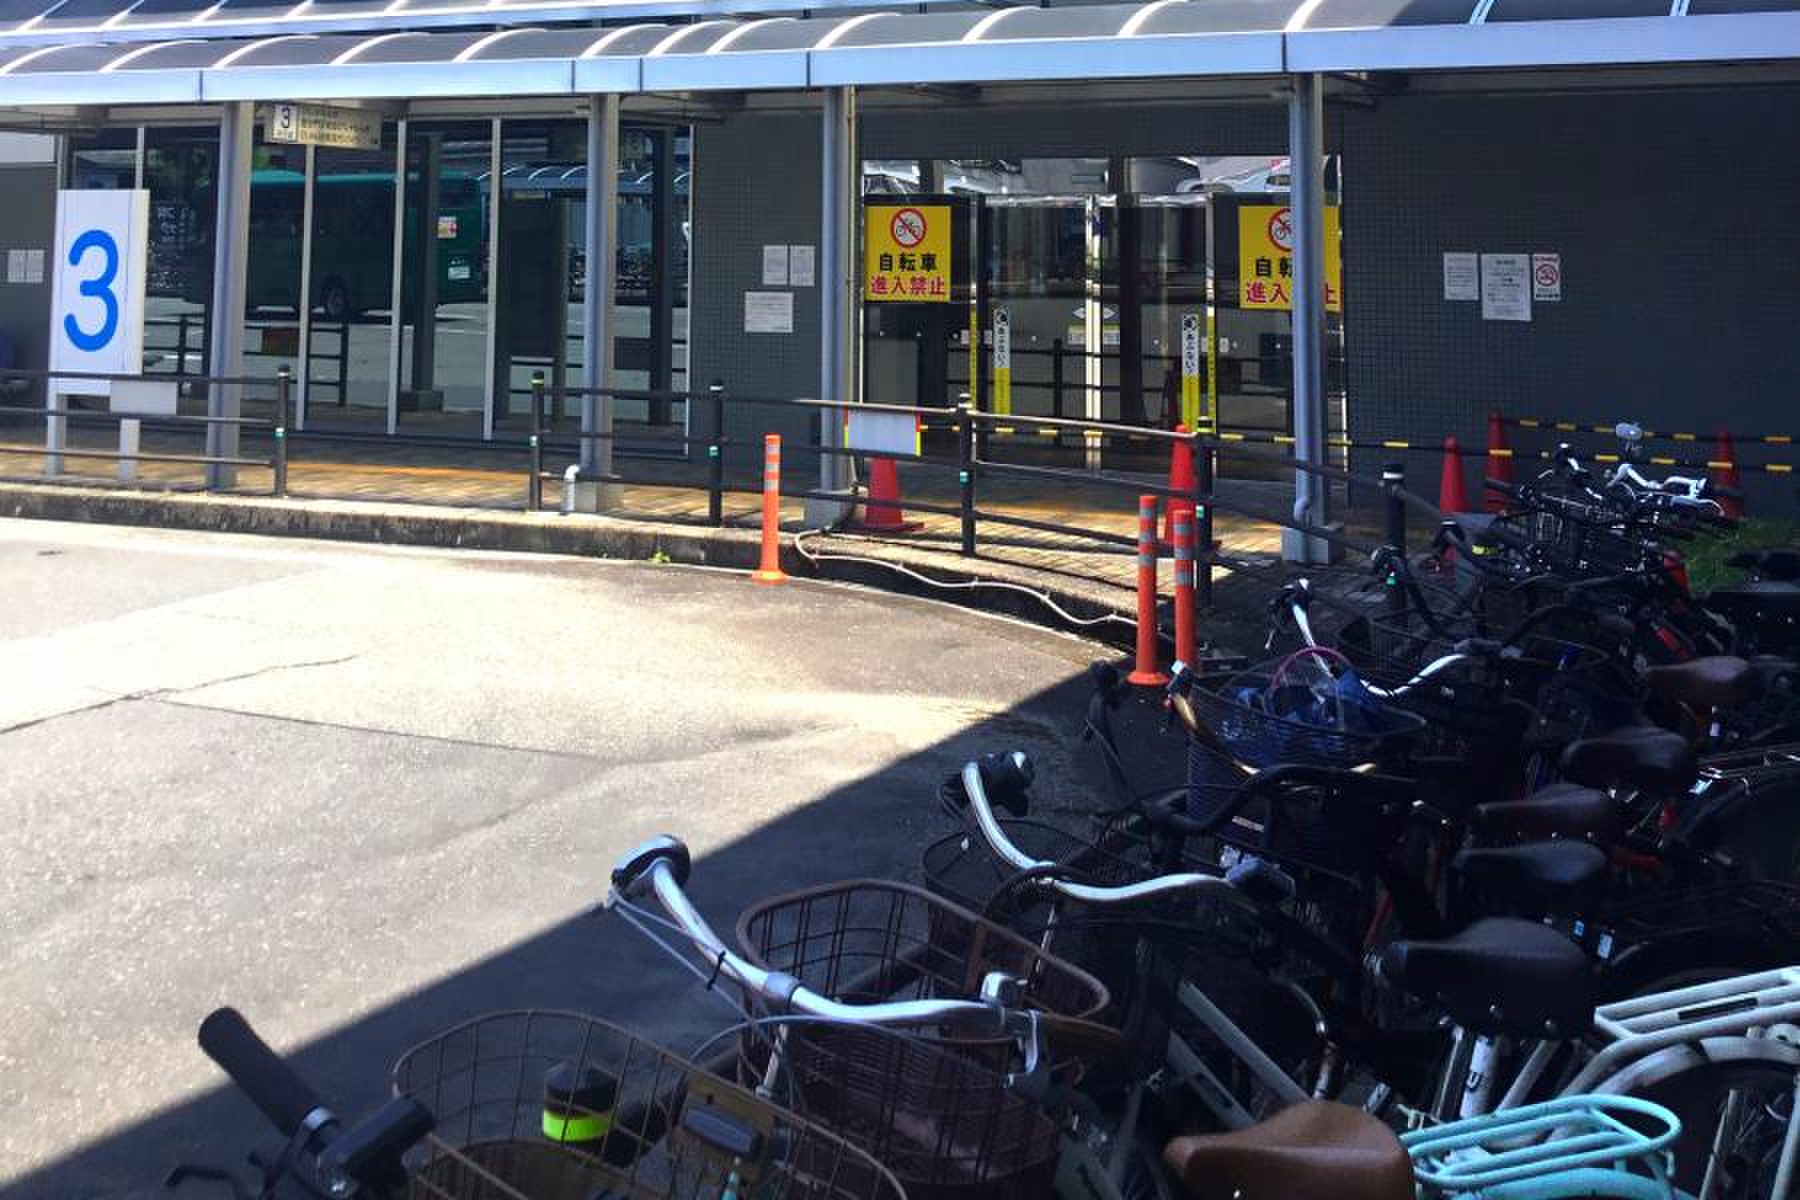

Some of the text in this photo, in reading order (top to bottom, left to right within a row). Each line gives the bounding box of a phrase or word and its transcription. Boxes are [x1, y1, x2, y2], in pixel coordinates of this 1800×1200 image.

[281, 106, 291, 129] 3
[879, 251, 938, 272] 自転車
[1255, 256, 1293, 278] 自転
[64, 229, 119, 352] 3
[871, 274, 945, 295] 進入禁止
[1245, 280, 1338, 305] 進入止
